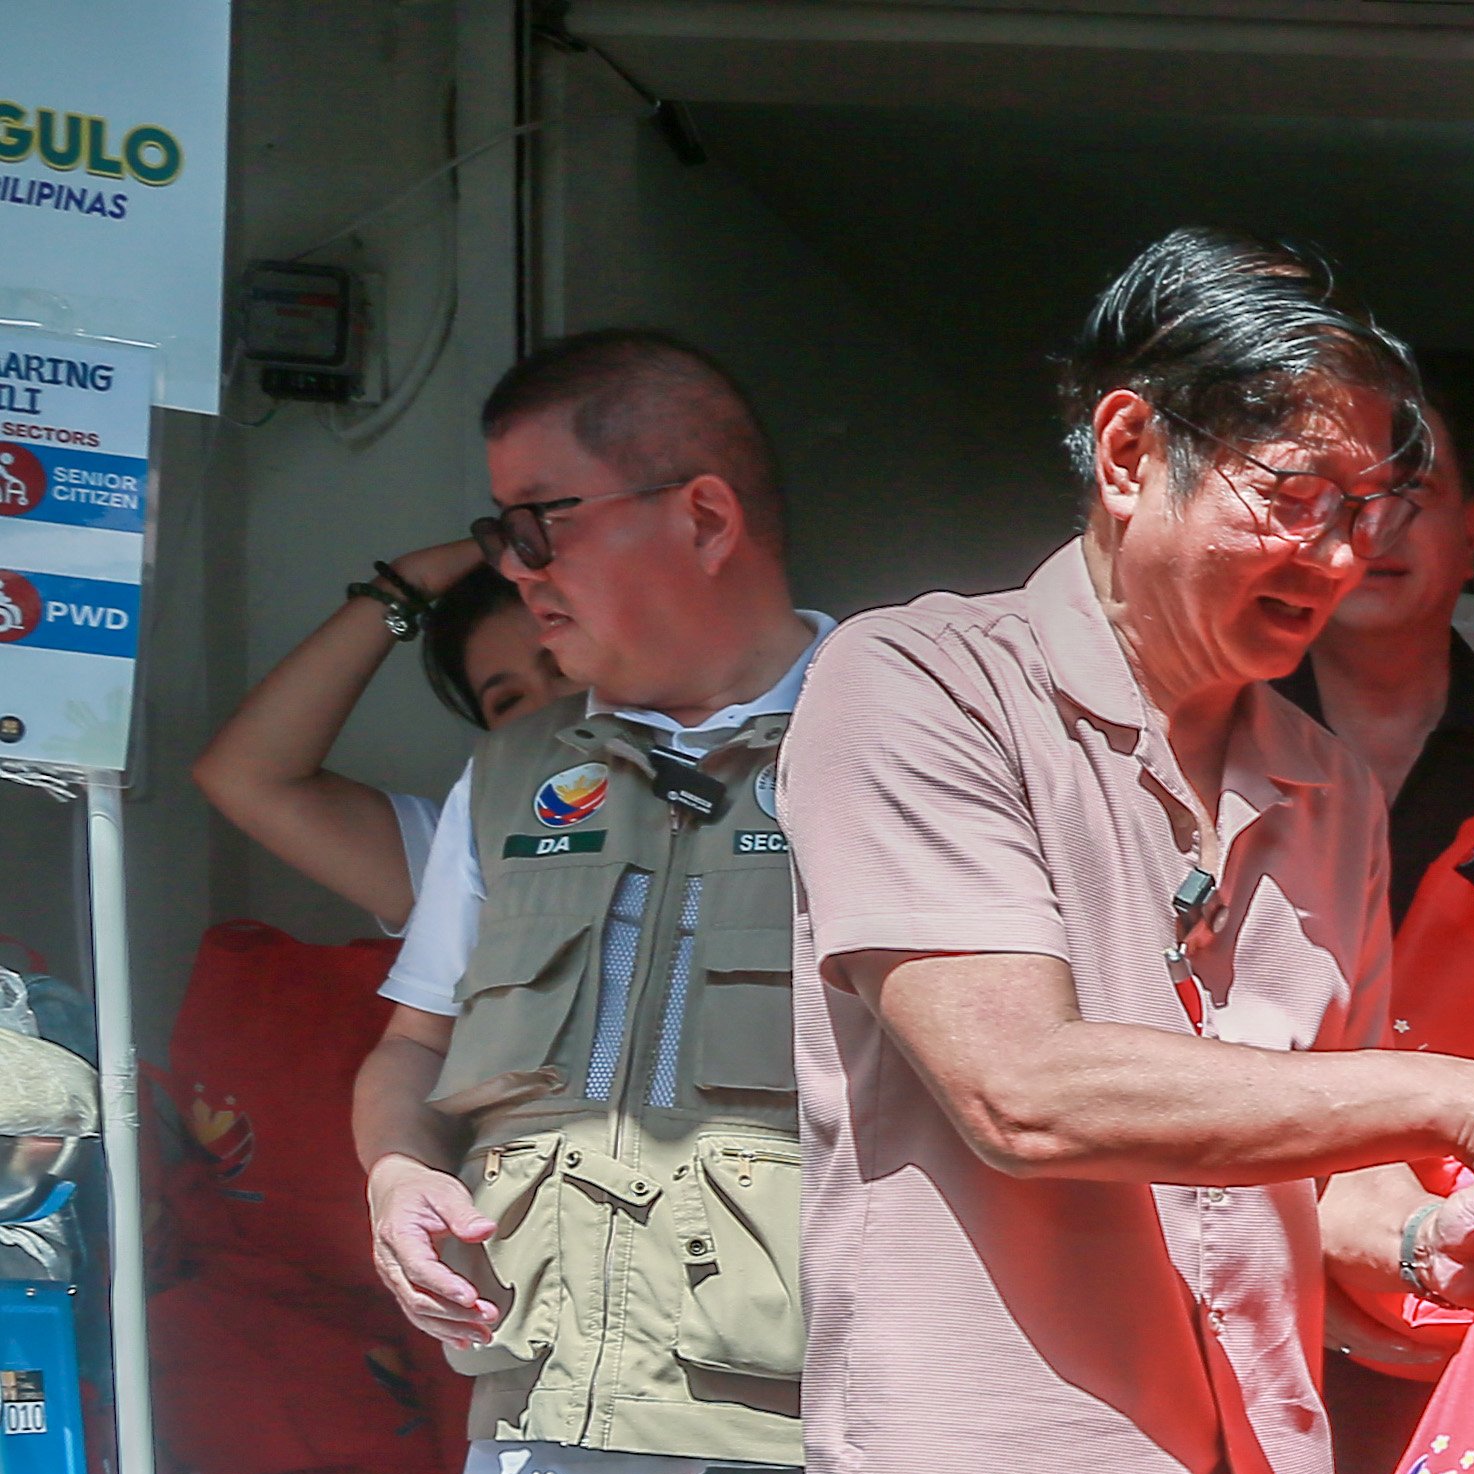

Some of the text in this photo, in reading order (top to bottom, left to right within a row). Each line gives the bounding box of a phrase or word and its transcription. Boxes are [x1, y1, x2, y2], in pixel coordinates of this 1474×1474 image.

[0, 175, 129, 219] ILIPINAS
[2, 422, 100, 448] SECTORS
[53, 467, 138, 492] SENIOR
[53, 485, 139, 510] CITIZEN
[46, 600, 129, 630] PWD
[536, 835, 571, 855] DA
